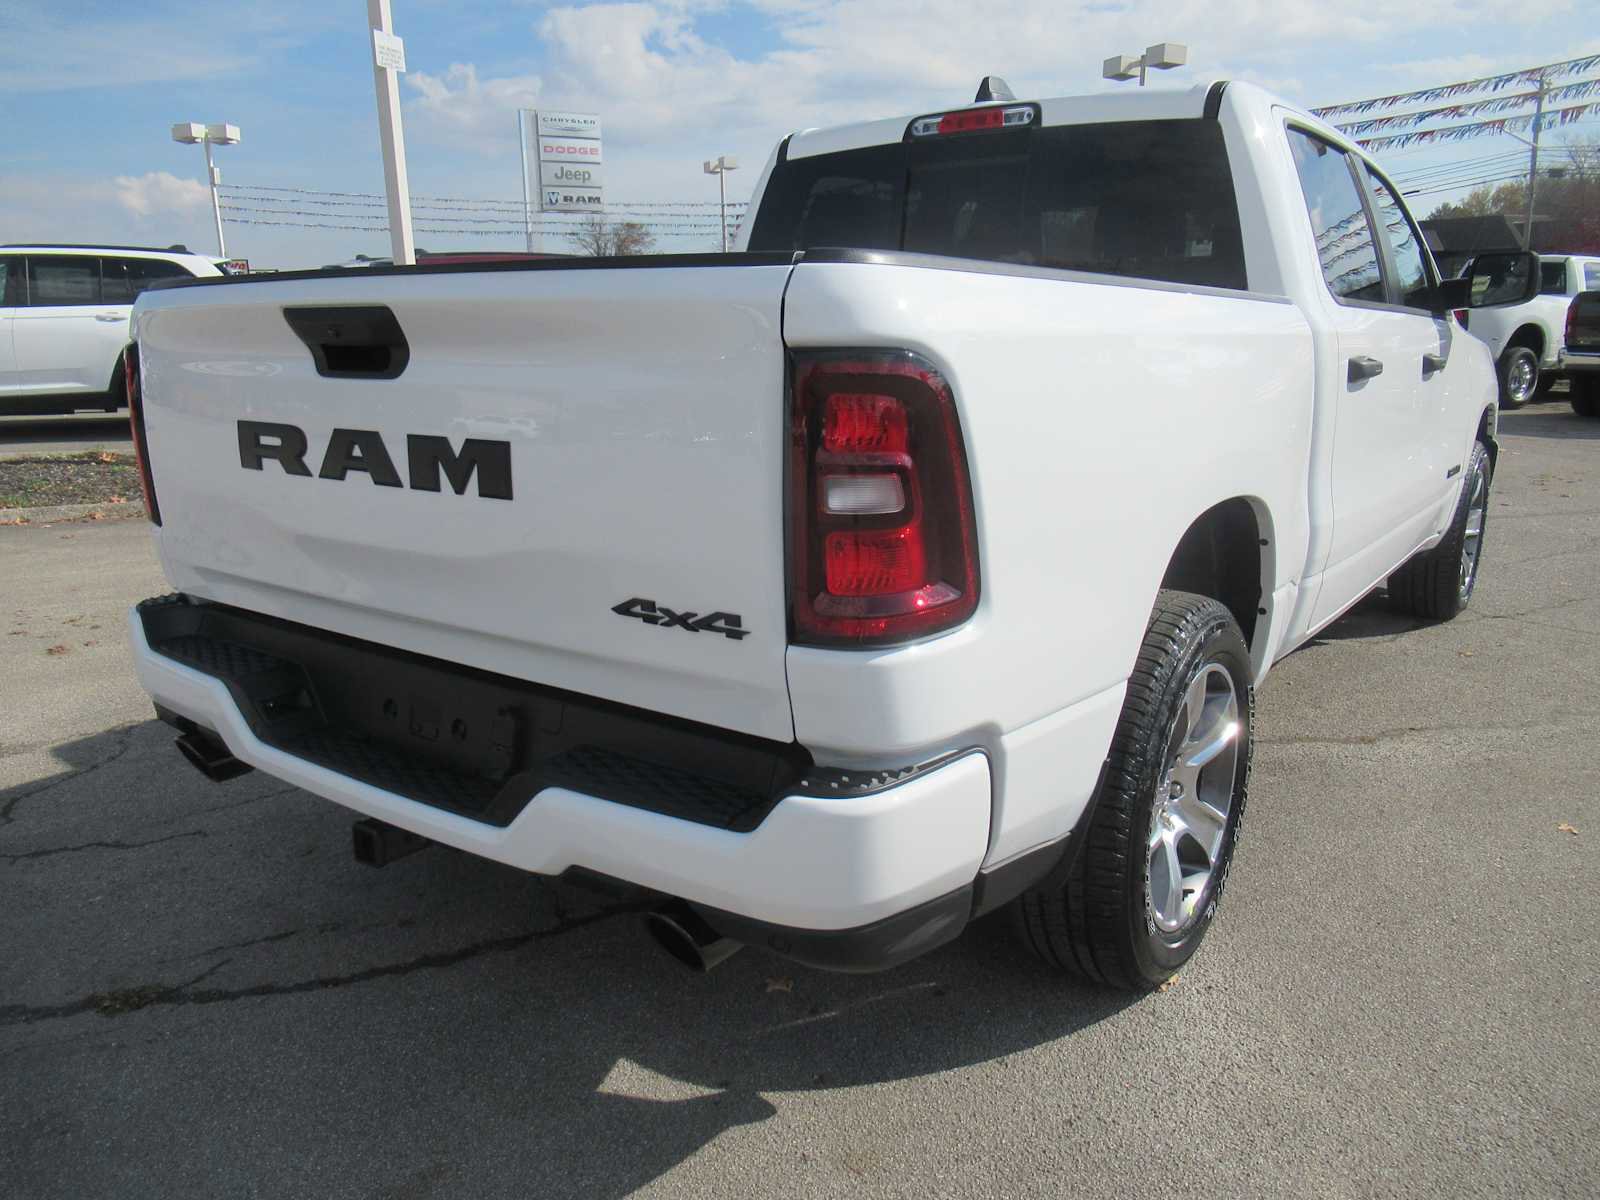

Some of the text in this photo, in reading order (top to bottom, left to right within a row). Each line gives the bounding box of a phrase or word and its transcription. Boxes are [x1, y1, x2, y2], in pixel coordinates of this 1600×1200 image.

[543, 117, 596, 125] CHRYSLER
[543, 146, 599, 155] DODGE
[554, 166, 592, 183] Jeep
[563, 195, 601, 204] RAM
[237, 419, 514, 500] RAM
[611, 598, 751, 640] 4x4
